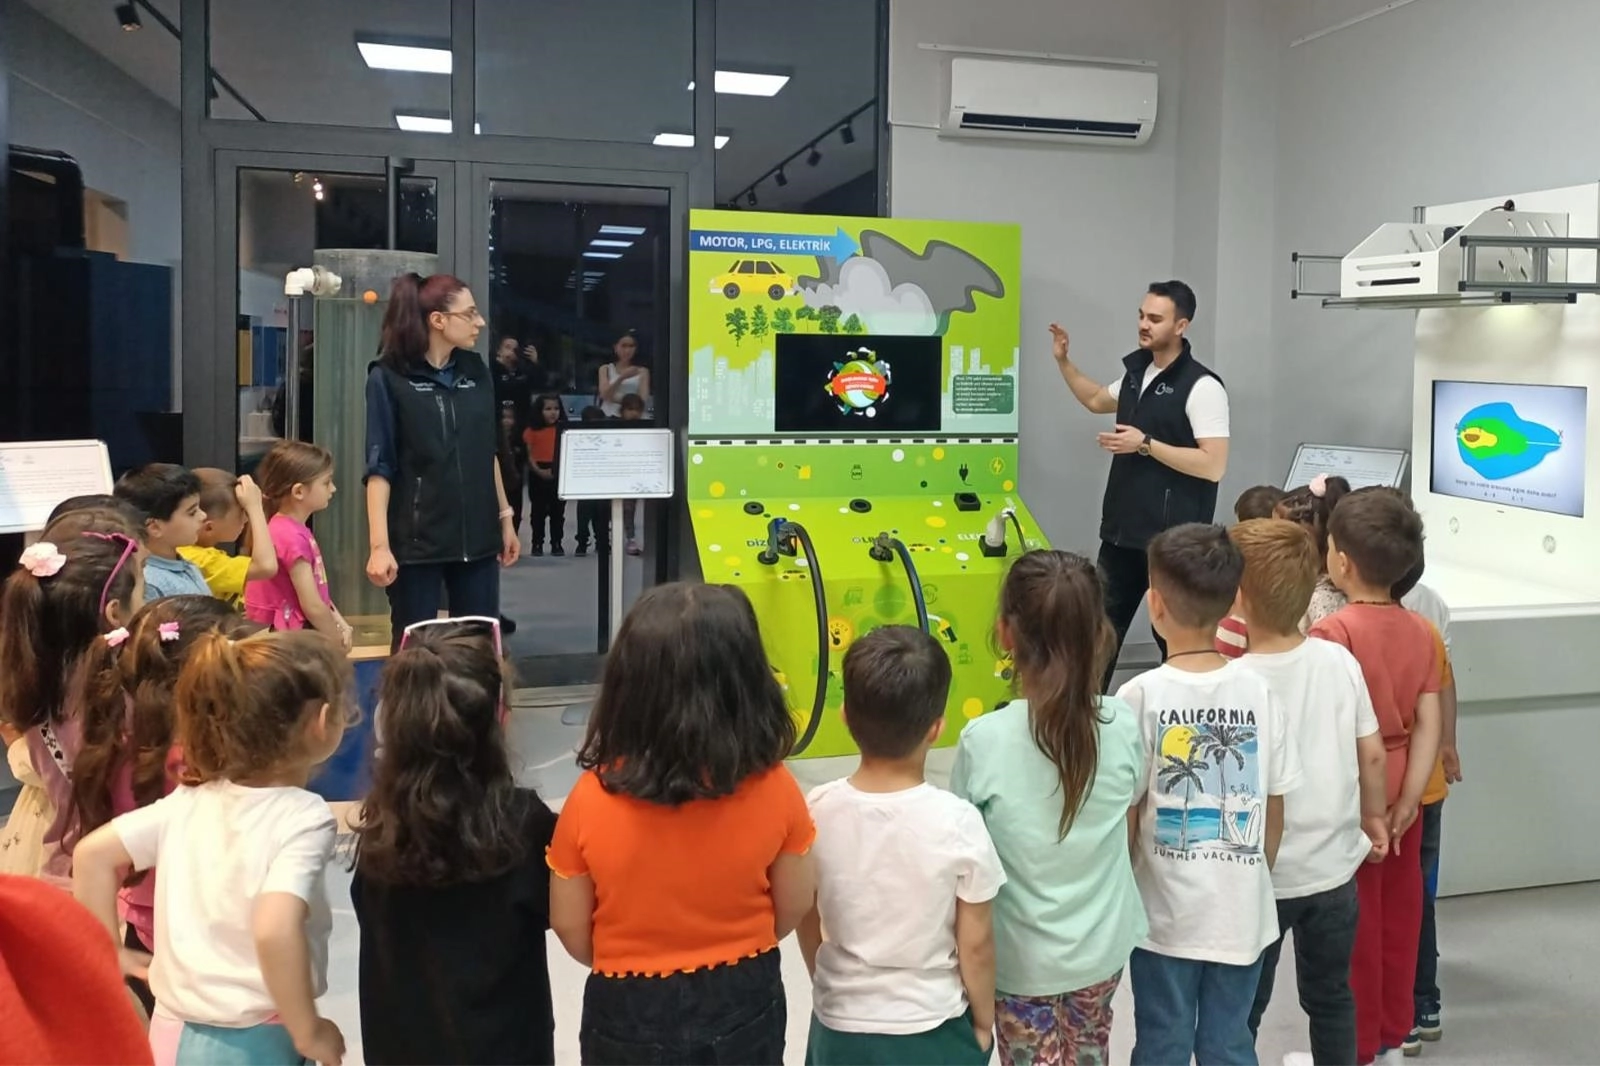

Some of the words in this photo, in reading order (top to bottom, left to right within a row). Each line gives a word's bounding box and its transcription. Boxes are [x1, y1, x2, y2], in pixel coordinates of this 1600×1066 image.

[700, 235, 748, 250] MOTOR,
[751, 238, 776, 251] LPG,
[780, 238, 831, 251] ELEKTRİK
[1160, 708, 1256, 725] CALIFORNIA
[1153, 846, 1197, 861] SUMMER
[1203, 852, 1262, 866] VACATION
